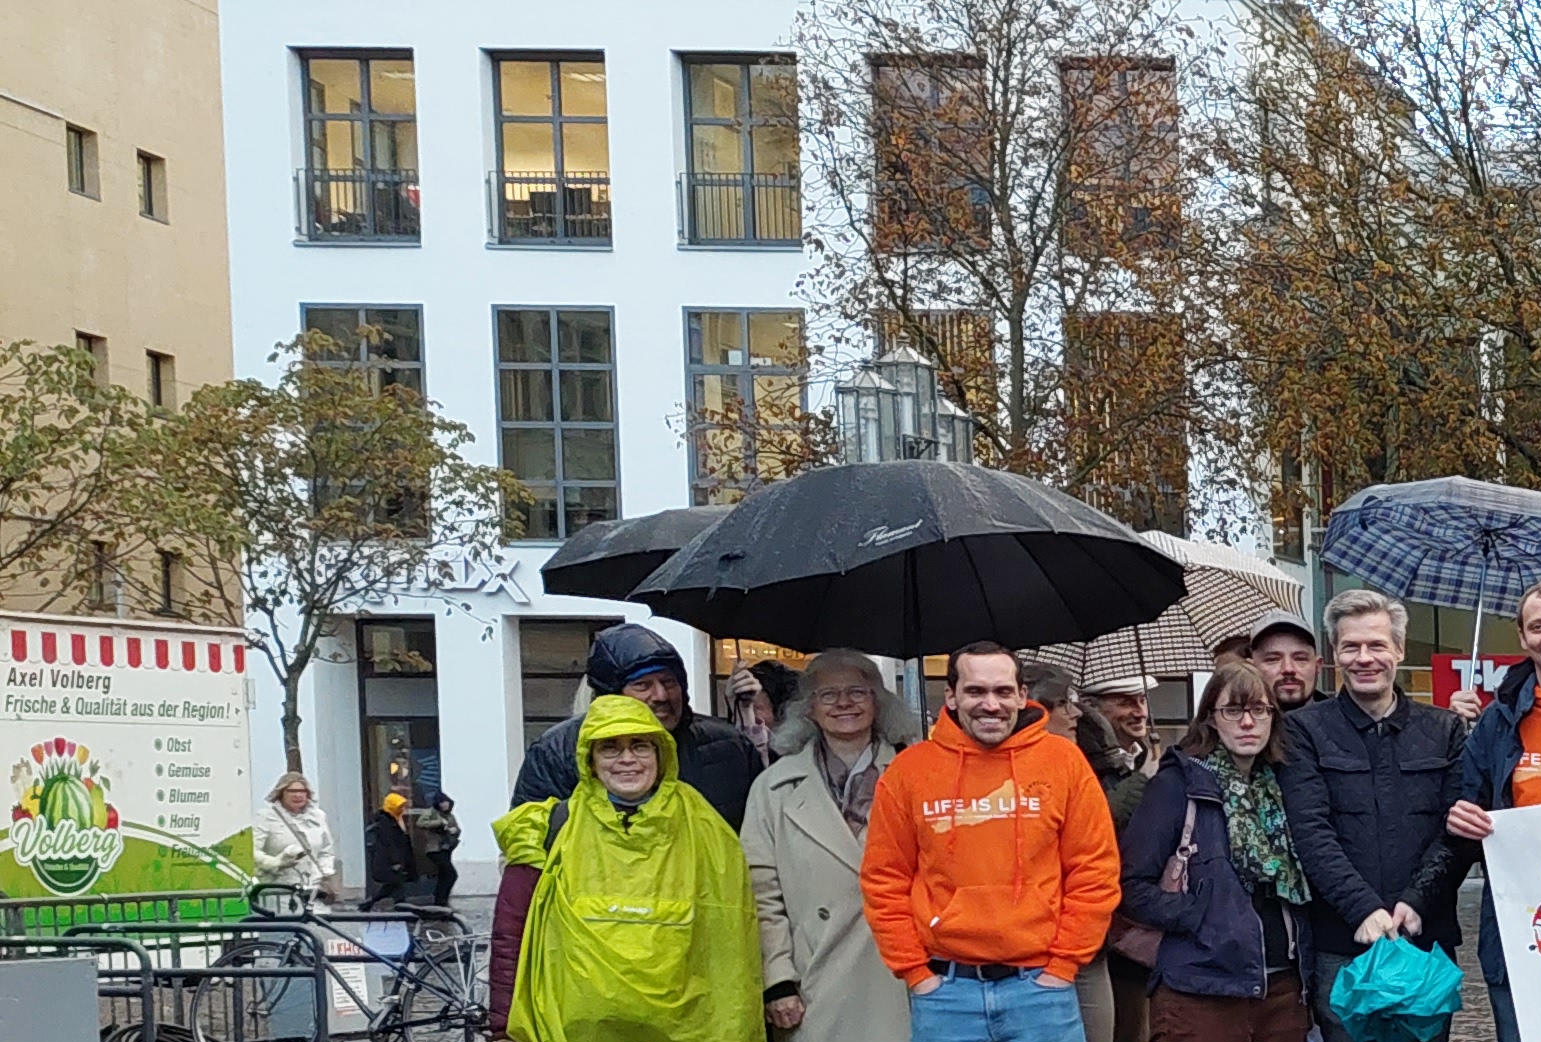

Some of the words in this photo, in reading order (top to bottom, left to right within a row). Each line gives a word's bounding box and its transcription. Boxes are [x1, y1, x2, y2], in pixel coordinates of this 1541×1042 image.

[6, 667, 43, 687] Axel
[50, 669, 112, 694] Volberg
[4, 694, 57, 714] Frische
[61, 696, 71, 714] &
[75, 697, 127, 716] Qualität
[131, 702, 154, 717] aus
[158, 700, 179, 718] der
[182, 701, 230, 721] Region!
[167, 737, 192, 752] Obst
[168, 763, 211, 778] Gemüse
[169, 789, 210, 803] Blumen
[923, 799, 965, 815] LIFE
[971, 798, 991, 812] IS
[170, 814, 200, 831] Honig
[14, 817, 118, 864] Volberg
